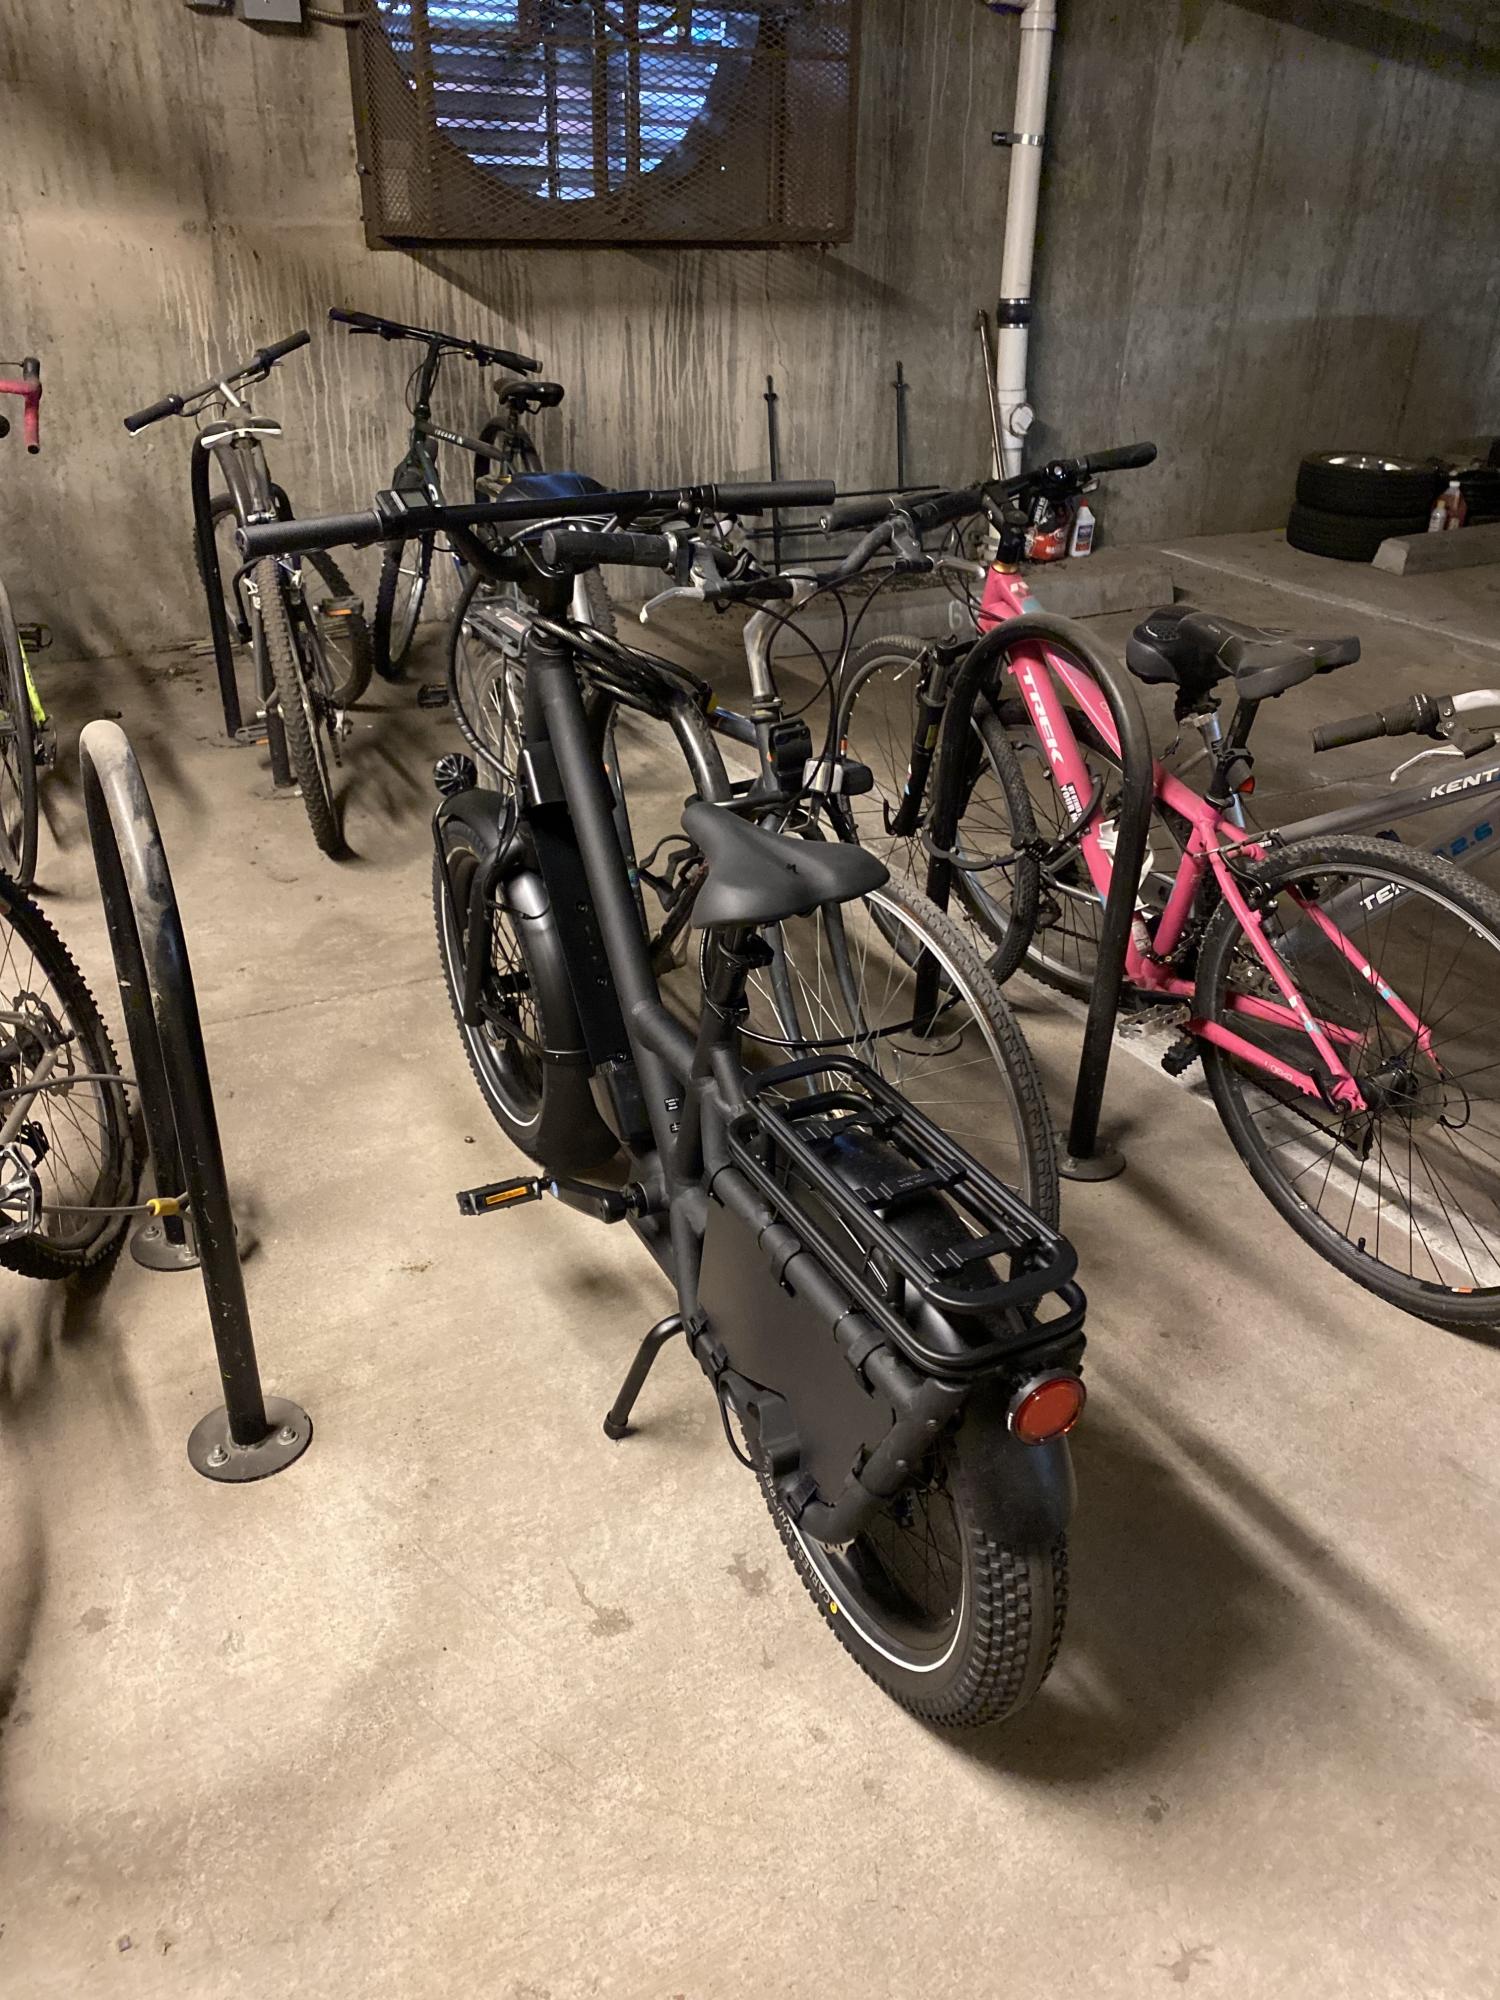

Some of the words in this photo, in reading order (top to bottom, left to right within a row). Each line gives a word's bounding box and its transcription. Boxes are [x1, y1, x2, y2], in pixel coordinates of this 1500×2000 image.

[1022, 665, 1065, 765] TREK
[1060, 784, 1075, 813] YOUR
[1430, 767, 1499, 799] KENT
[1450, 821, 1493, 857] 2.6
[793, 1541, 832, 1605] CARLESS
